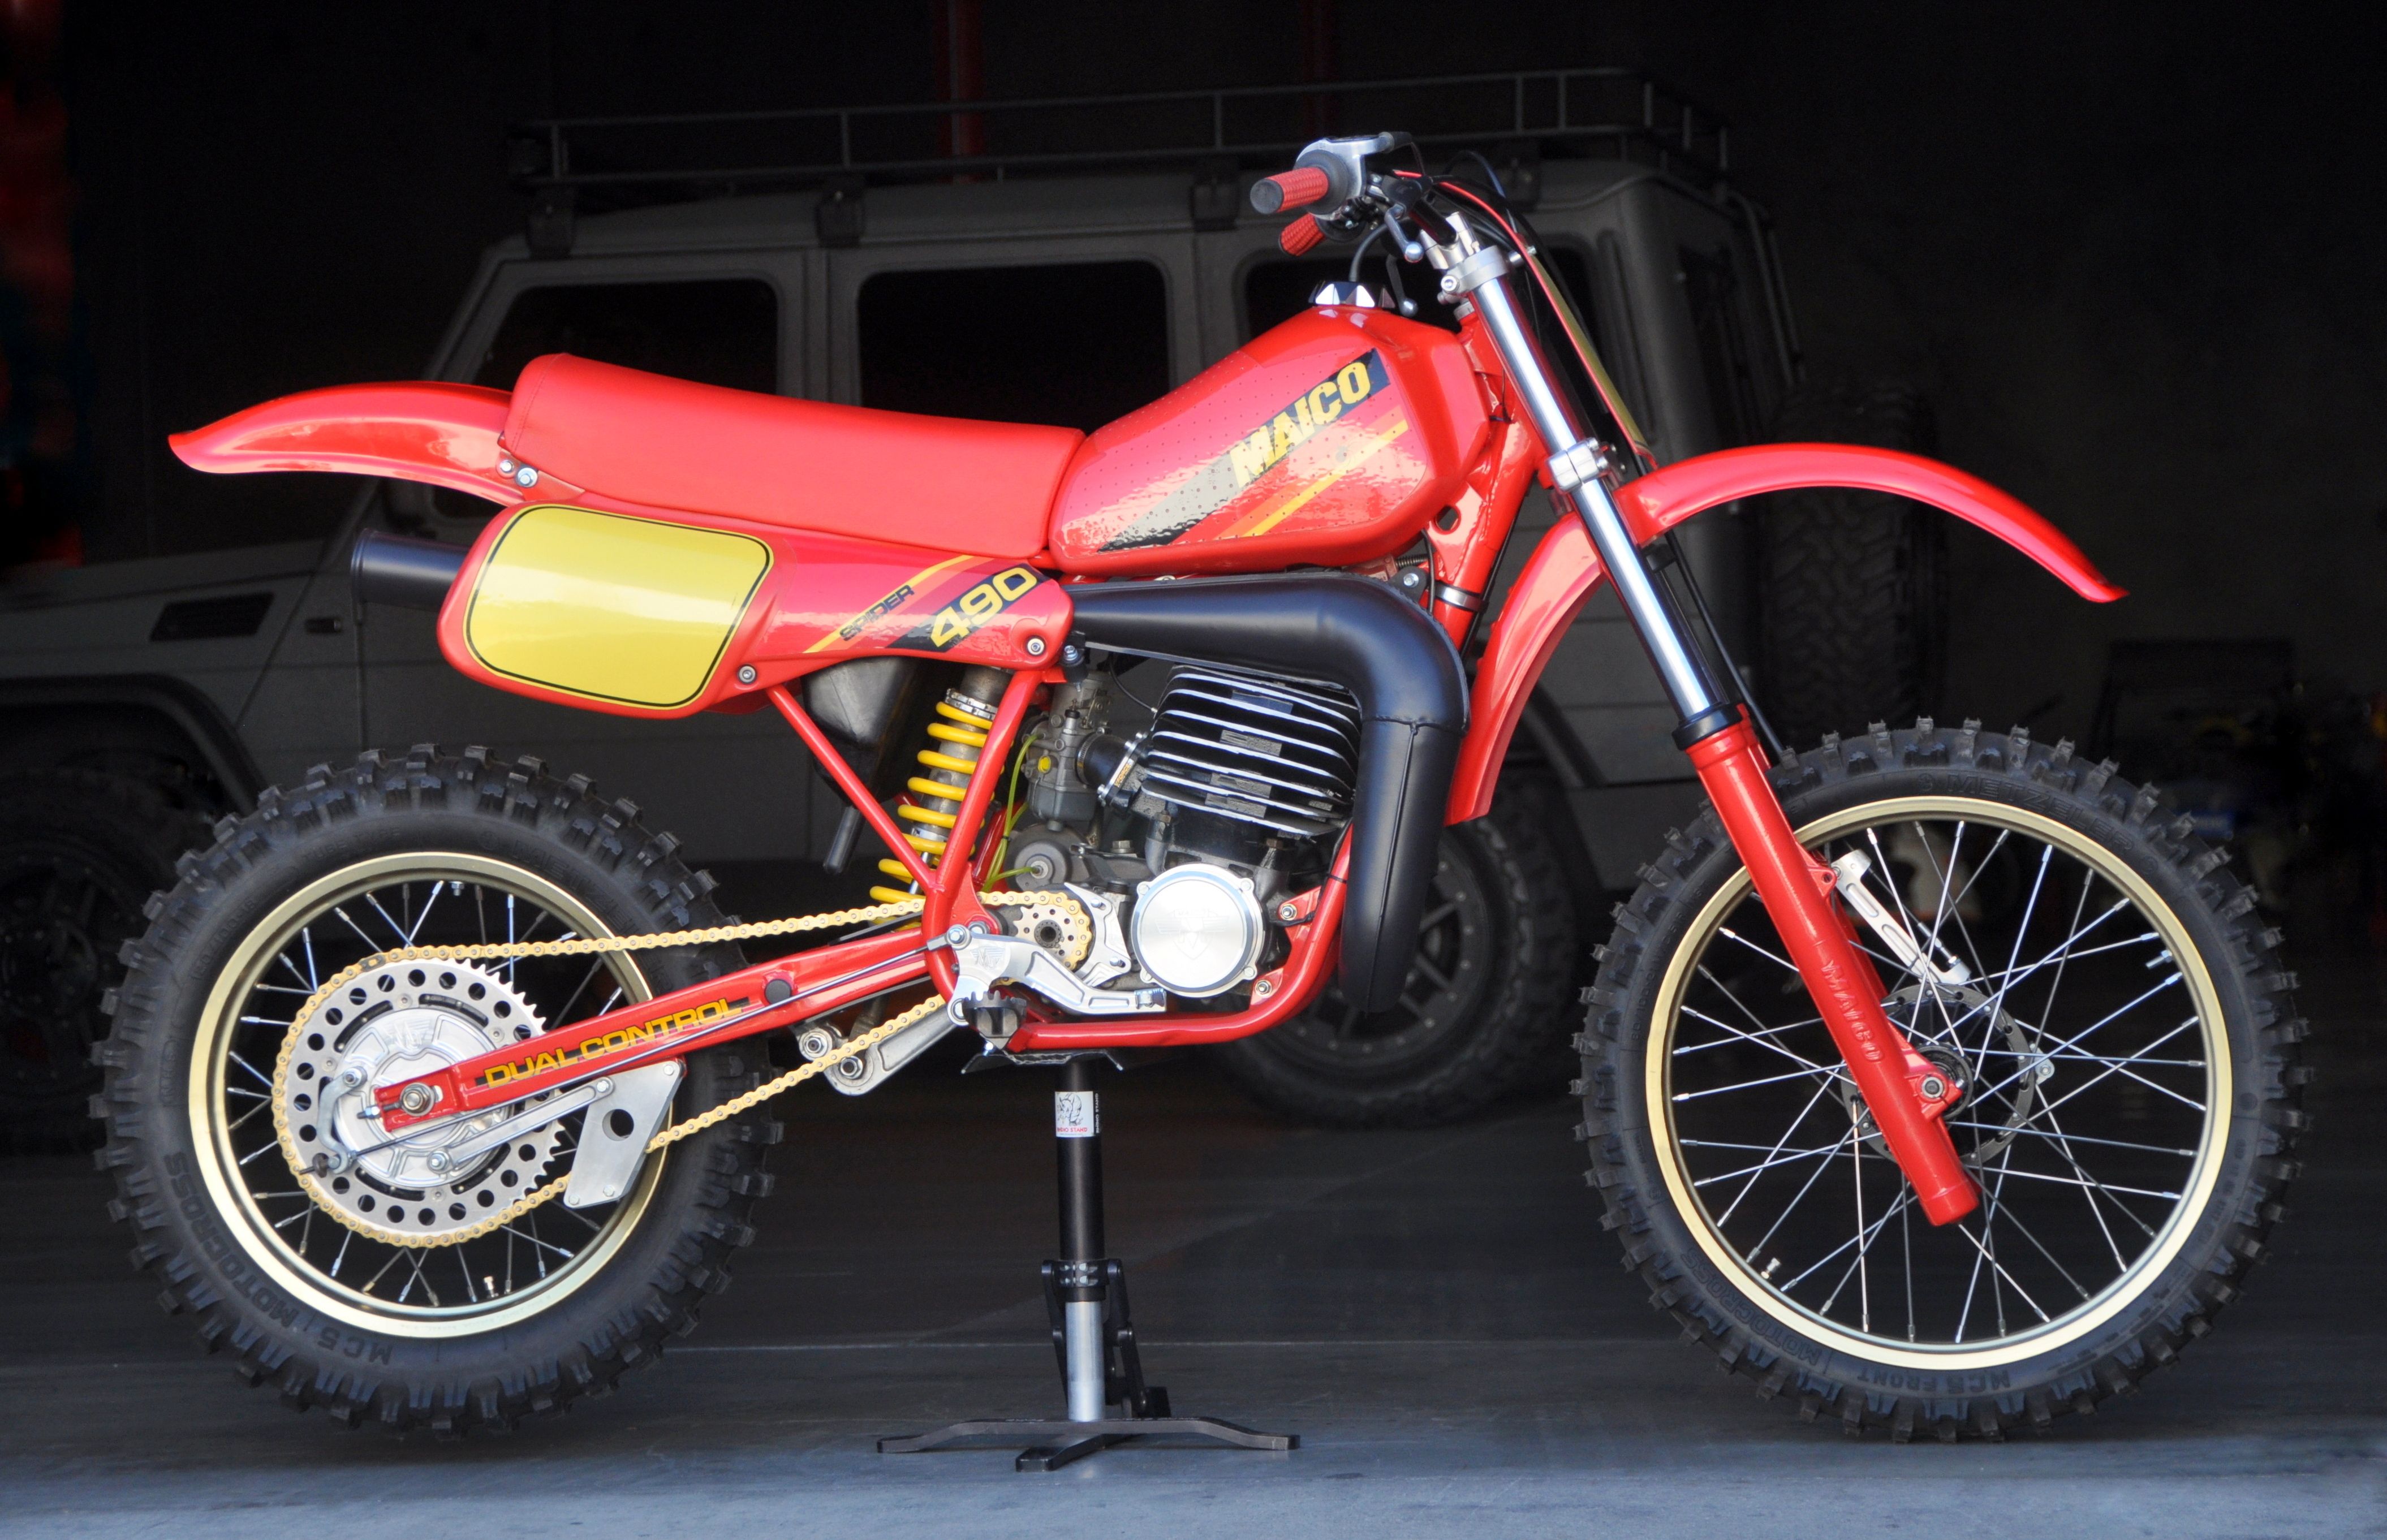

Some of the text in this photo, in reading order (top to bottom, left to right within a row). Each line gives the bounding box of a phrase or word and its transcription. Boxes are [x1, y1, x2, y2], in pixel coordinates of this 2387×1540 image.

[1229, 361, 1372, 488] MAICO
[839, 584, 915, 642] SPIDER
[930, 567, 1037, 648] 490
[484, 998, 742, 1089] DUAL CONTROL
[1821, 959, 1885, 1061] MAICO
[162, 1150, 299, 1330] MOTOCROSS
[1678, 1245, 1823, 1368] MOTOCROSS
[1856, 1366, 1937, 1392] FRONT
